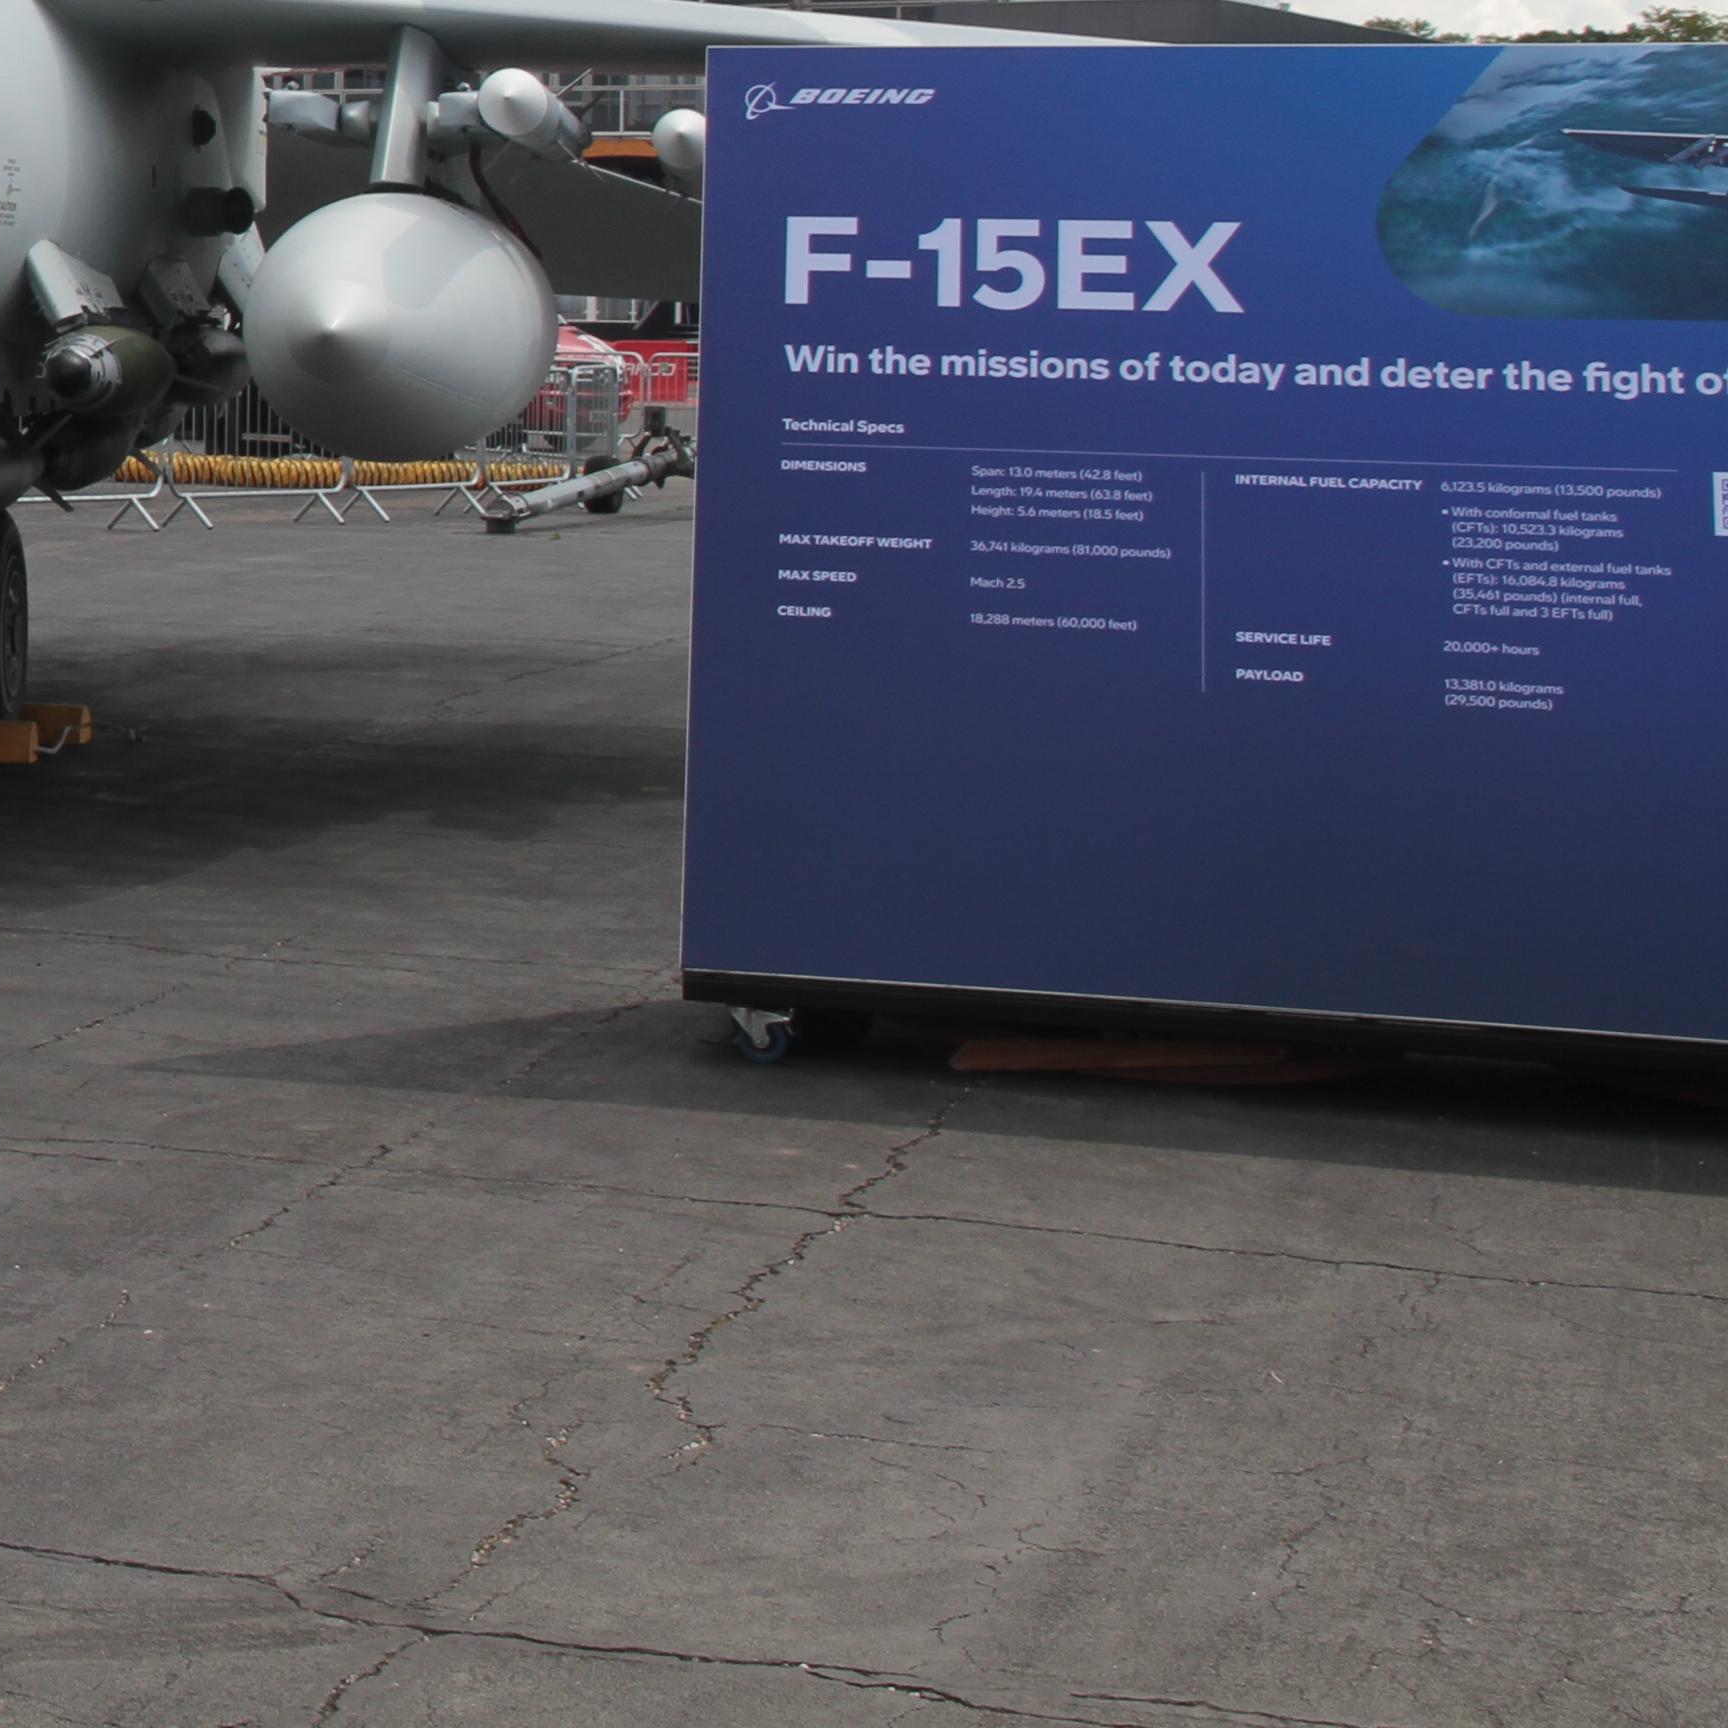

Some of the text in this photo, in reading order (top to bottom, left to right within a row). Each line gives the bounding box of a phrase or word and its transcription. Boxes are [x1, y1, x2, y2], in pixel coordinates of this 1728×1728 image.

[789, 88, 936, 105] BOEING
[785, 216, 1244, 313] F-15EX
[785, 345, 858, 373] Win
[869, 346, 931, 375] the
[942, 349, 1110, 380] missions
[1120, 352, 1160, 380] of
[1169, 354, 1285, 390] today
[1295, 357, 1369, 386] and
[1381, 358, 1493, 389] deter
[1503, 361, 1573, 391] the
[1583, 362, 1685, 400] fight
[781, 417, 905, 436] Technical Specs
[780, 459, 867, 473] DIMENSIONS
[970, 464, 1143, 483] Span: 13.0 meters (42.8 feet)
[1235, 474, 1423, 491] INTERNAL FUEL CAPACITY
[1440, 480, 1662, 500] 6,123.5 kilograms (13,500 pounds)
[970, 485, 1153, 503] Length: 19.4 meters (63.8 feet)
[970, 504, 1145, 522] Height: 5.6 meters (18.5 feet)
[1450, 506, 1619, 523] With conformal fuel tanks
[1451, 521, 1625, 540] (CFTs): 10,523.3 kilograms
[778, 533, 933, 549] MAX TAKEOFF WEIGHT
[970, 539, 1172, 560] 36,741 kilograms (81,000 pounds)
[1451, 536, 1560, 553] (23,200 pounds)
[777, 569, 858, 583] MAX SPEED
[1451, 557, 1673, 577] With CFTs and external fuel tanks
[969, 576, 1026, 590] Mach 2.5
[1452, 572, 1499, 587] (EFTs):
[1560, 576, 1627, 591] kilograms
[1452, 587, 1501, 601] (35,461
[1502, 591, 1558, 604] pounds)
[1560, 592, 1616, 606] (internal
[776, 604, 832, 618] CEILING
[1452, 602, 1614, 622] CFTs full and 3 EFTs full)
[970, 612, 1138, 632] 18,288 meters (60,000 feet)
[1235, 631, 1332, 647] SERVICE LIFE
[1443, 640, 1540, 656] 20,000+ hours
[1235, 668, 1304, 682] PAYLOAD
[1444, 678, 1565, 696] 13,381.0 kilograms
[1444, 693, 1554, 712] (29,500 pounds)
